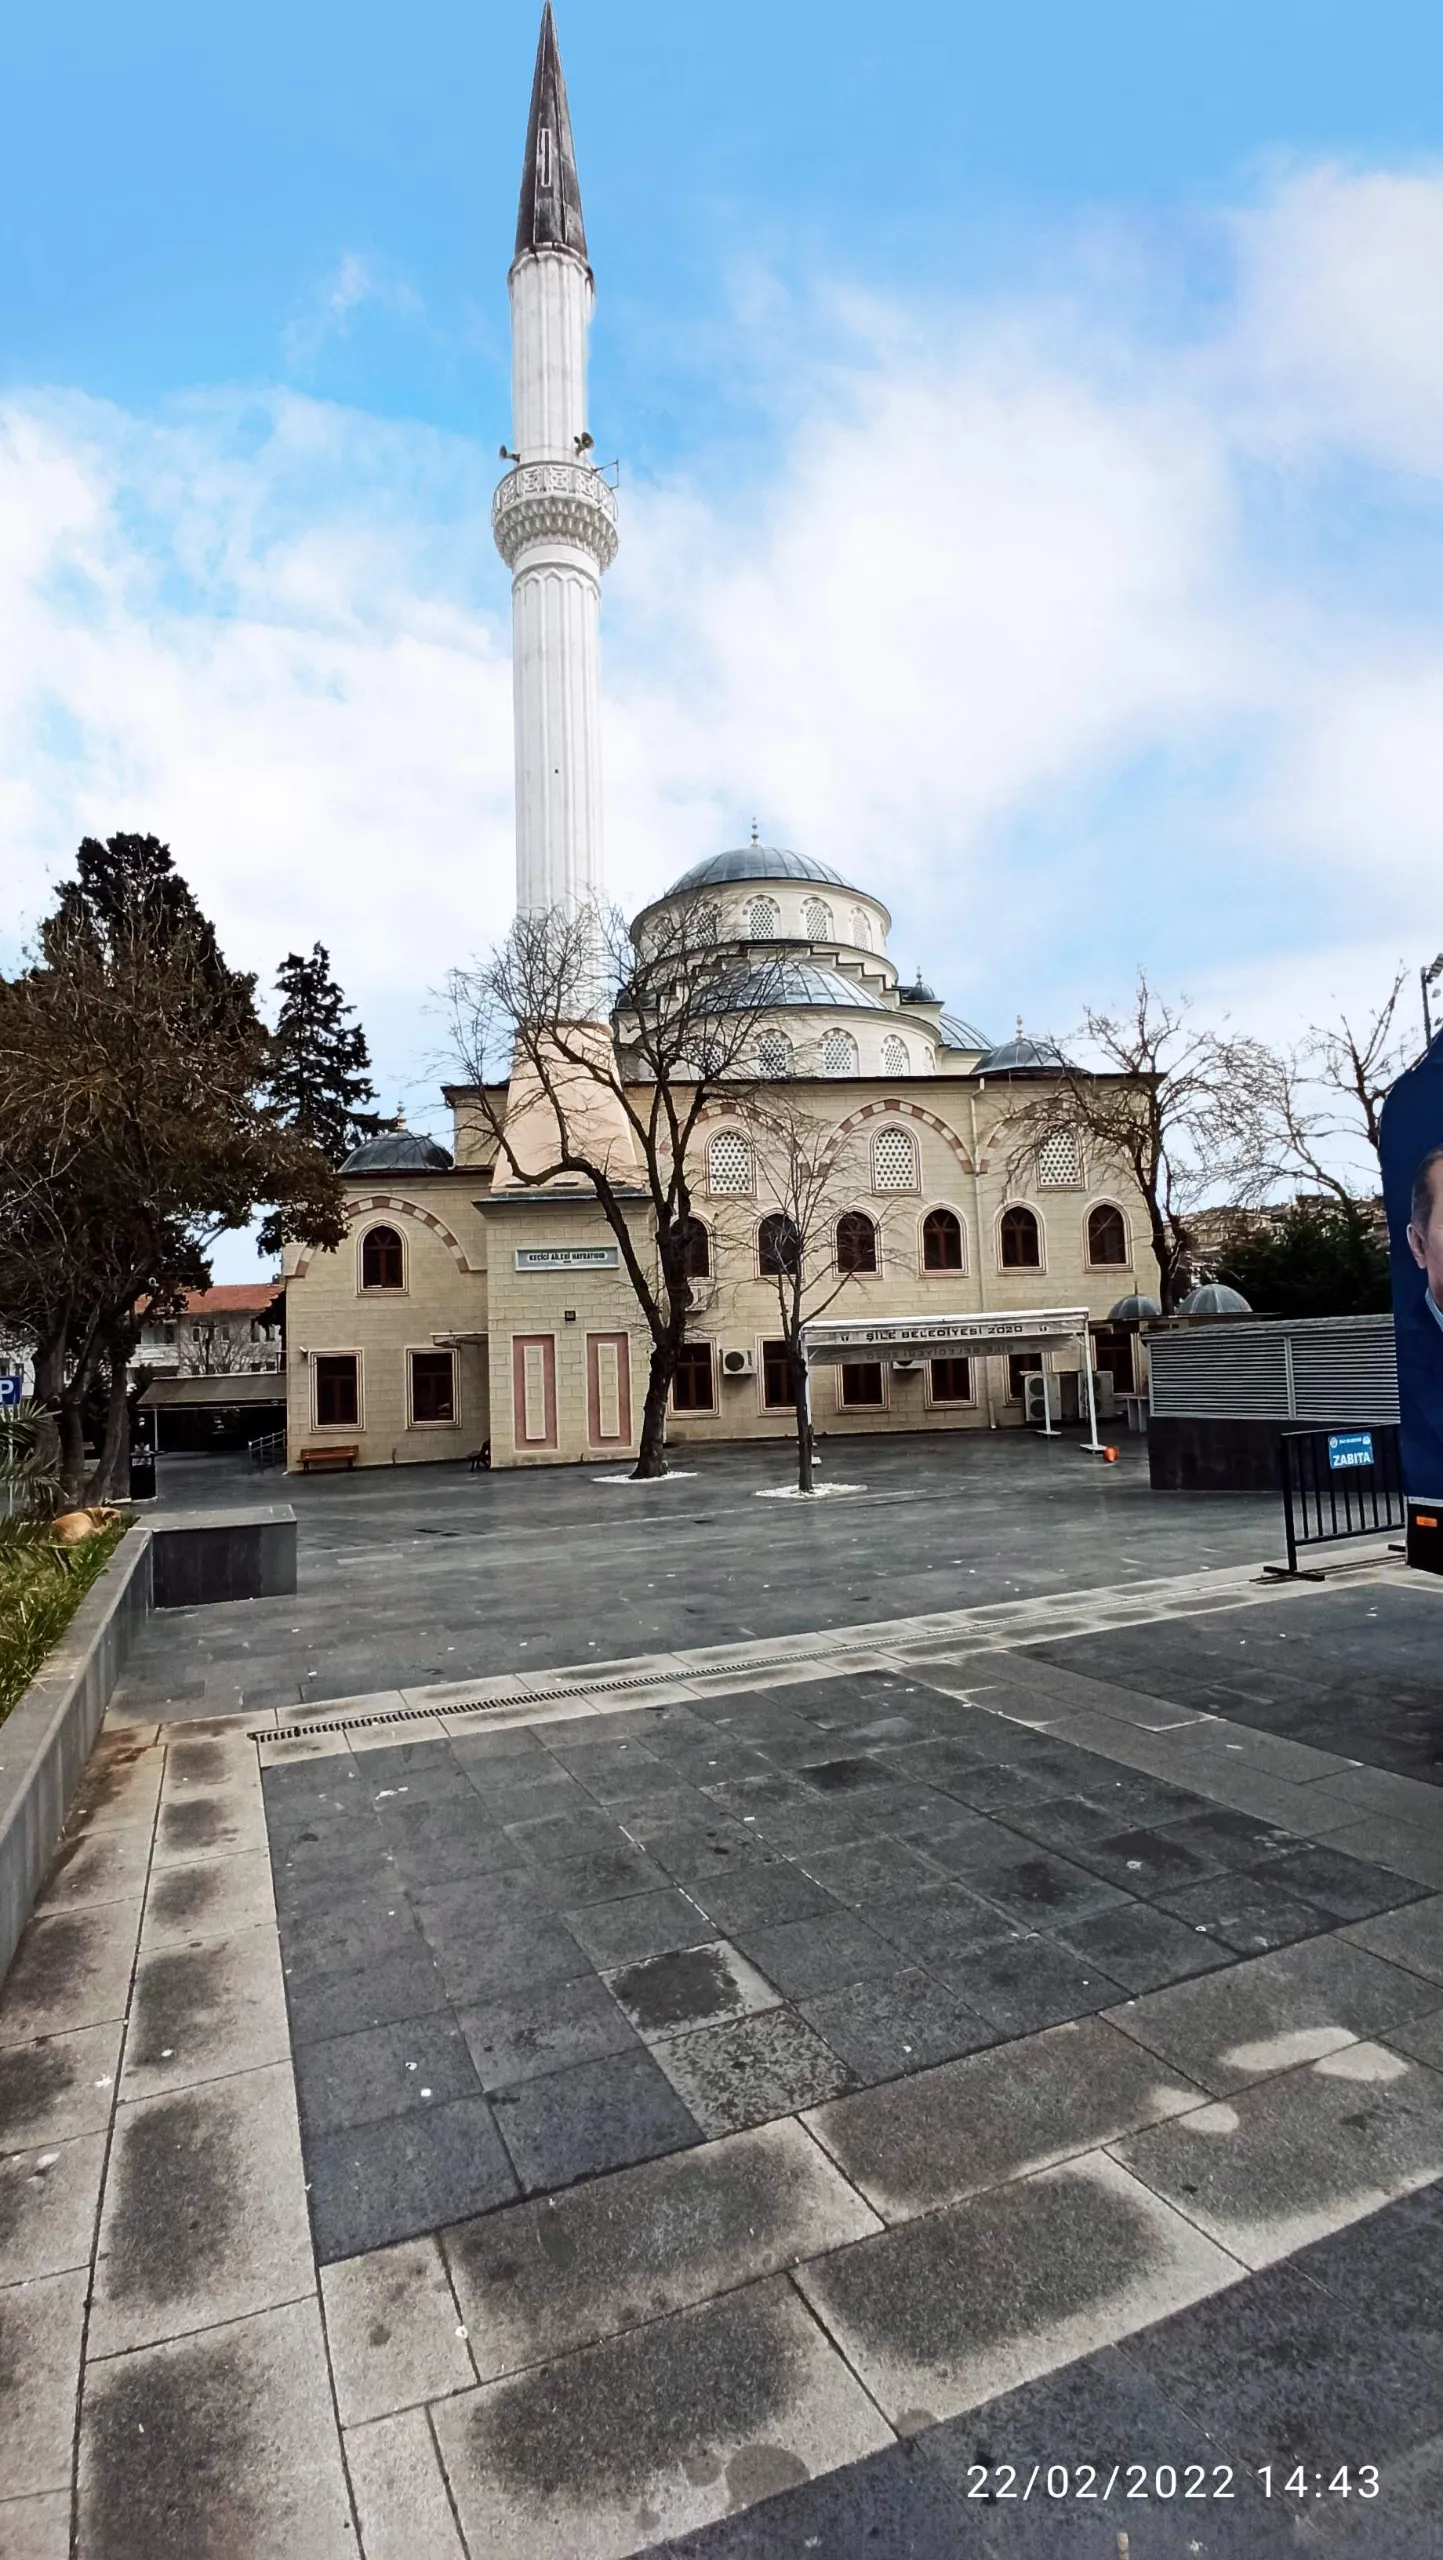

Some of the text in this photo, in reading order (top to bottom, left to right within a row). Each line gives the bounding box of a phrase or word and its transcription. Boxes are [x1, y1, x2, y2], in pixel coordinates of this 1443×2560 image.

[901, 1326, 982, 1339] BELEDİYESİ
[988, 1325, 1023, 1334] 2020
[0, 1380, 14, 1403] P
[1333, 1451, 1371, 1467] ZABITA
